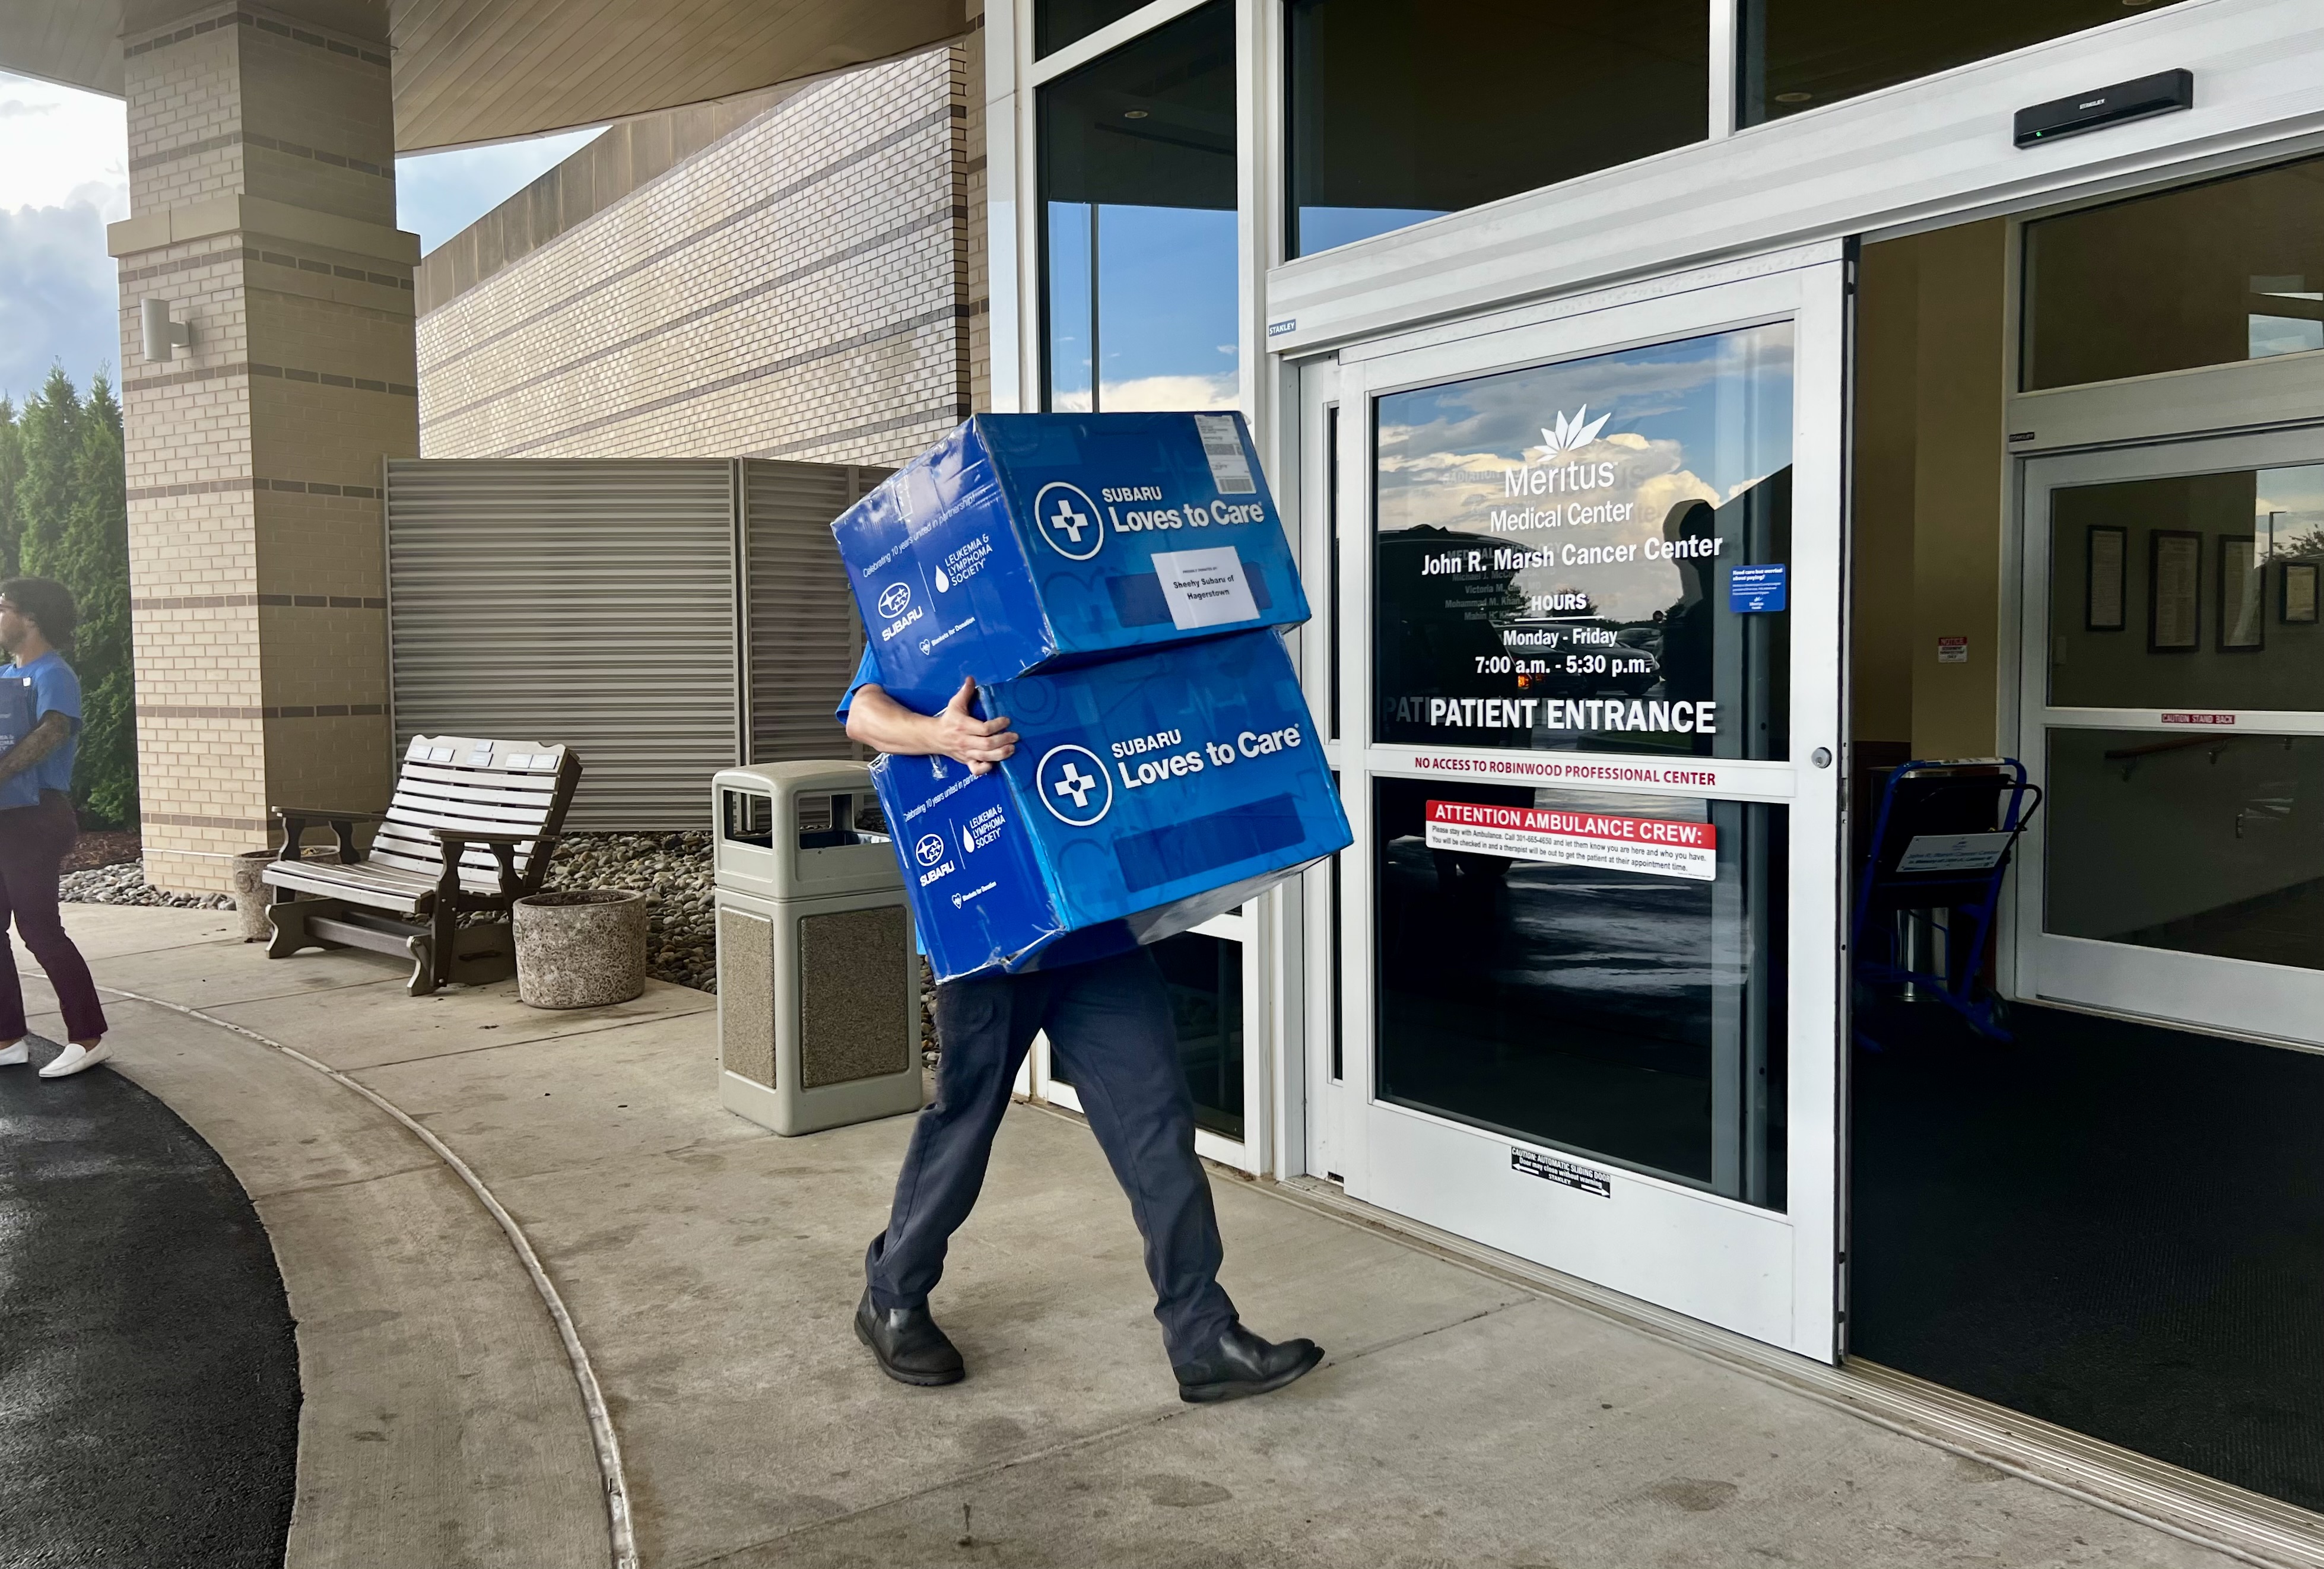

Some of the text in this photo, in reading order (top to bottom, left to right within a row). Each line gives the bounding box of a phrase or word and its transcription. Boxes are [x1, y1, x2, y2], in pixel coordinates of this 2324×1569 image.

[1269, 322, 1294, 335] STANLEY
[1505, 461, 1615, 498] Meritus
[1102, 486, 1162, 503] SUBARU
[1108, 500, 1265, 532] Loves to Care
[1491, 504, 1561, 532] Medical
[1567, 501, 1634, 526] Center
[863, 553, 891, 577] Celebrating
[891, 546, 899, 556] 10
[899, 536, 913, 554] years
[914, 522, 931, 541] united
[932, 520, 938, 528] in
[945, 533, 989, 567] LEUKEMIA &
[948, 544, 993, 576] LYMPHOMA
[1422, 535, 1723, 576] John R. Marsh Cancer Center
[951, 560, 985, 586] SOCIETY
[1173, 579, 1199, 589] Sheehy
[1201, 577, 1226, 586] Subaru
[1187, 589, 1230, 600] Hagerstown
[1531, 593, 1587, 611] HOURS
[882, 606, 923, 641] SUBARU
[1503, 630, 1559, 649] Monday
[1573, 628, 1618, 647] Friday
[1475, 656, 1510, 674] 7:00
[1516, 660, 1551, 674] a.m.
[1566, 656, 1606, 674] 5:30
[1612, 659, 1650, 677] p.m.
[1431, 698, 1716, 733] PATIENT ENTRANCE
[2163, 714, 2189, 723] CAUTION
[2192, 715, 2213, 723] STAND
[1112, 729, 1182, 758] SUBARU
[1118, 726, 1301, 789] Loves to Care
[1415, 757, 1716, 786] NO ACCESS TO ROBINWOOD PROFESSIONAL CENTER
[926, 799, 932, 808] 10
[932, 793, 944, 807] years
[944, 782, 958, 798] united
[958, 780, 963, 789] in
[970, 804, 1002, 828] LEUKEMIA &
[973, 815, 1005, 839] LYMPHOMA
[1436, 805, 1702, 844] ATTENTION AMBULANCE CREW:
[976, 828, 1001, 849] SOCIETY
[1433, 825, 1448, 834] Please
[1631, 846, 1644, 855] here
[1689, 852, 1706, 861] have.
[1504, 844, 1527, 853] therapist
[1587, 853, 1607, 862] patient
[1631, 859, 1671, 870] appointment
[1672, 863, 1688, 871] time.
[920, 860, 955, 887] SUBARU
[1519, 1158, 1602, 1188] Door may close without warning
[1538, 1155, 1569, 1171] AUTOMATIC
[1570, 1165, 1592, 1177] SLIDING
[1594, 1172, 1610, 1183] DOOR
[1548, 1173, 1571, 1185] STANLEY
